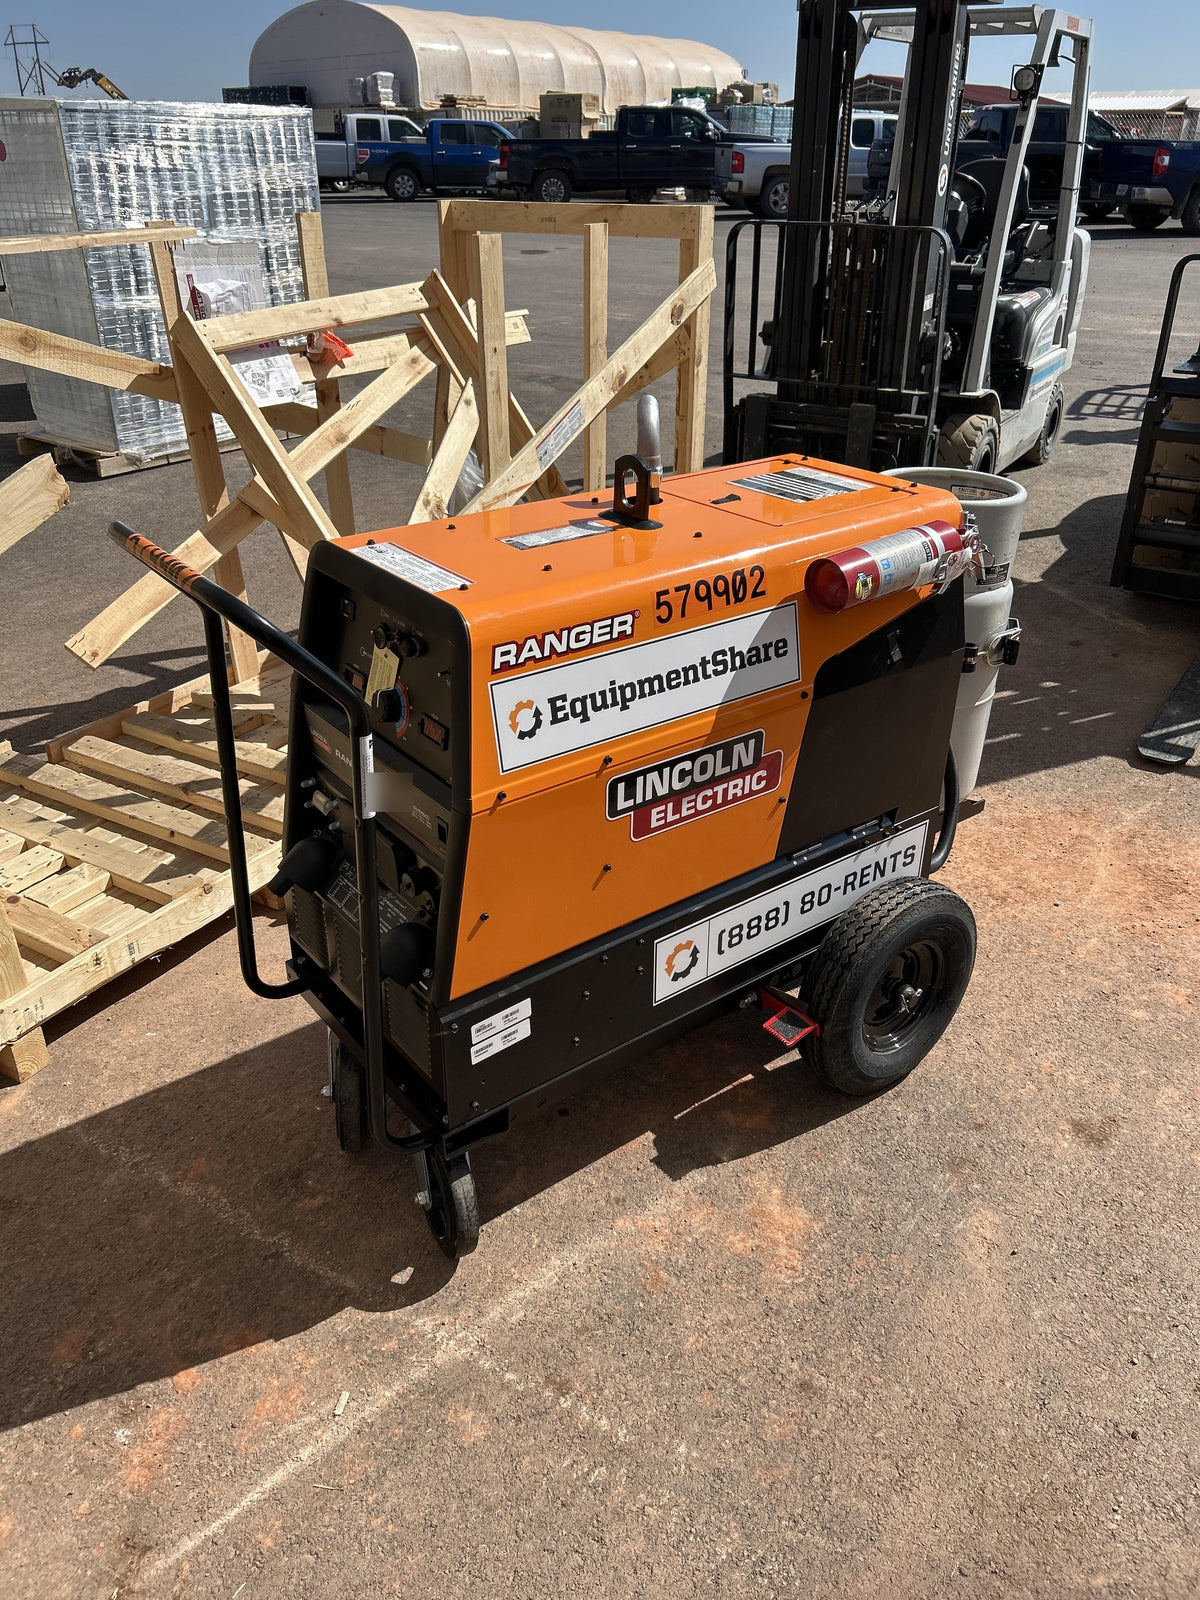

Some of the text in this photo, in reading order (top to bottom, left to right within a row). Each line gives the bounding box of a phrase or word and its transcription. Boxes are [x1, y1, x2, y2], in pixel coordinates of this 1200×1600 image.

[655, 565, 766, 624] 579902
[548, 637, 788, 725] EquipmentShare
[617, 738, 756, 811] LINCOLN
[650, 769, 767, 829] ELECTRIC
[717, 844, 917, 955] (888) 80-RENTS
